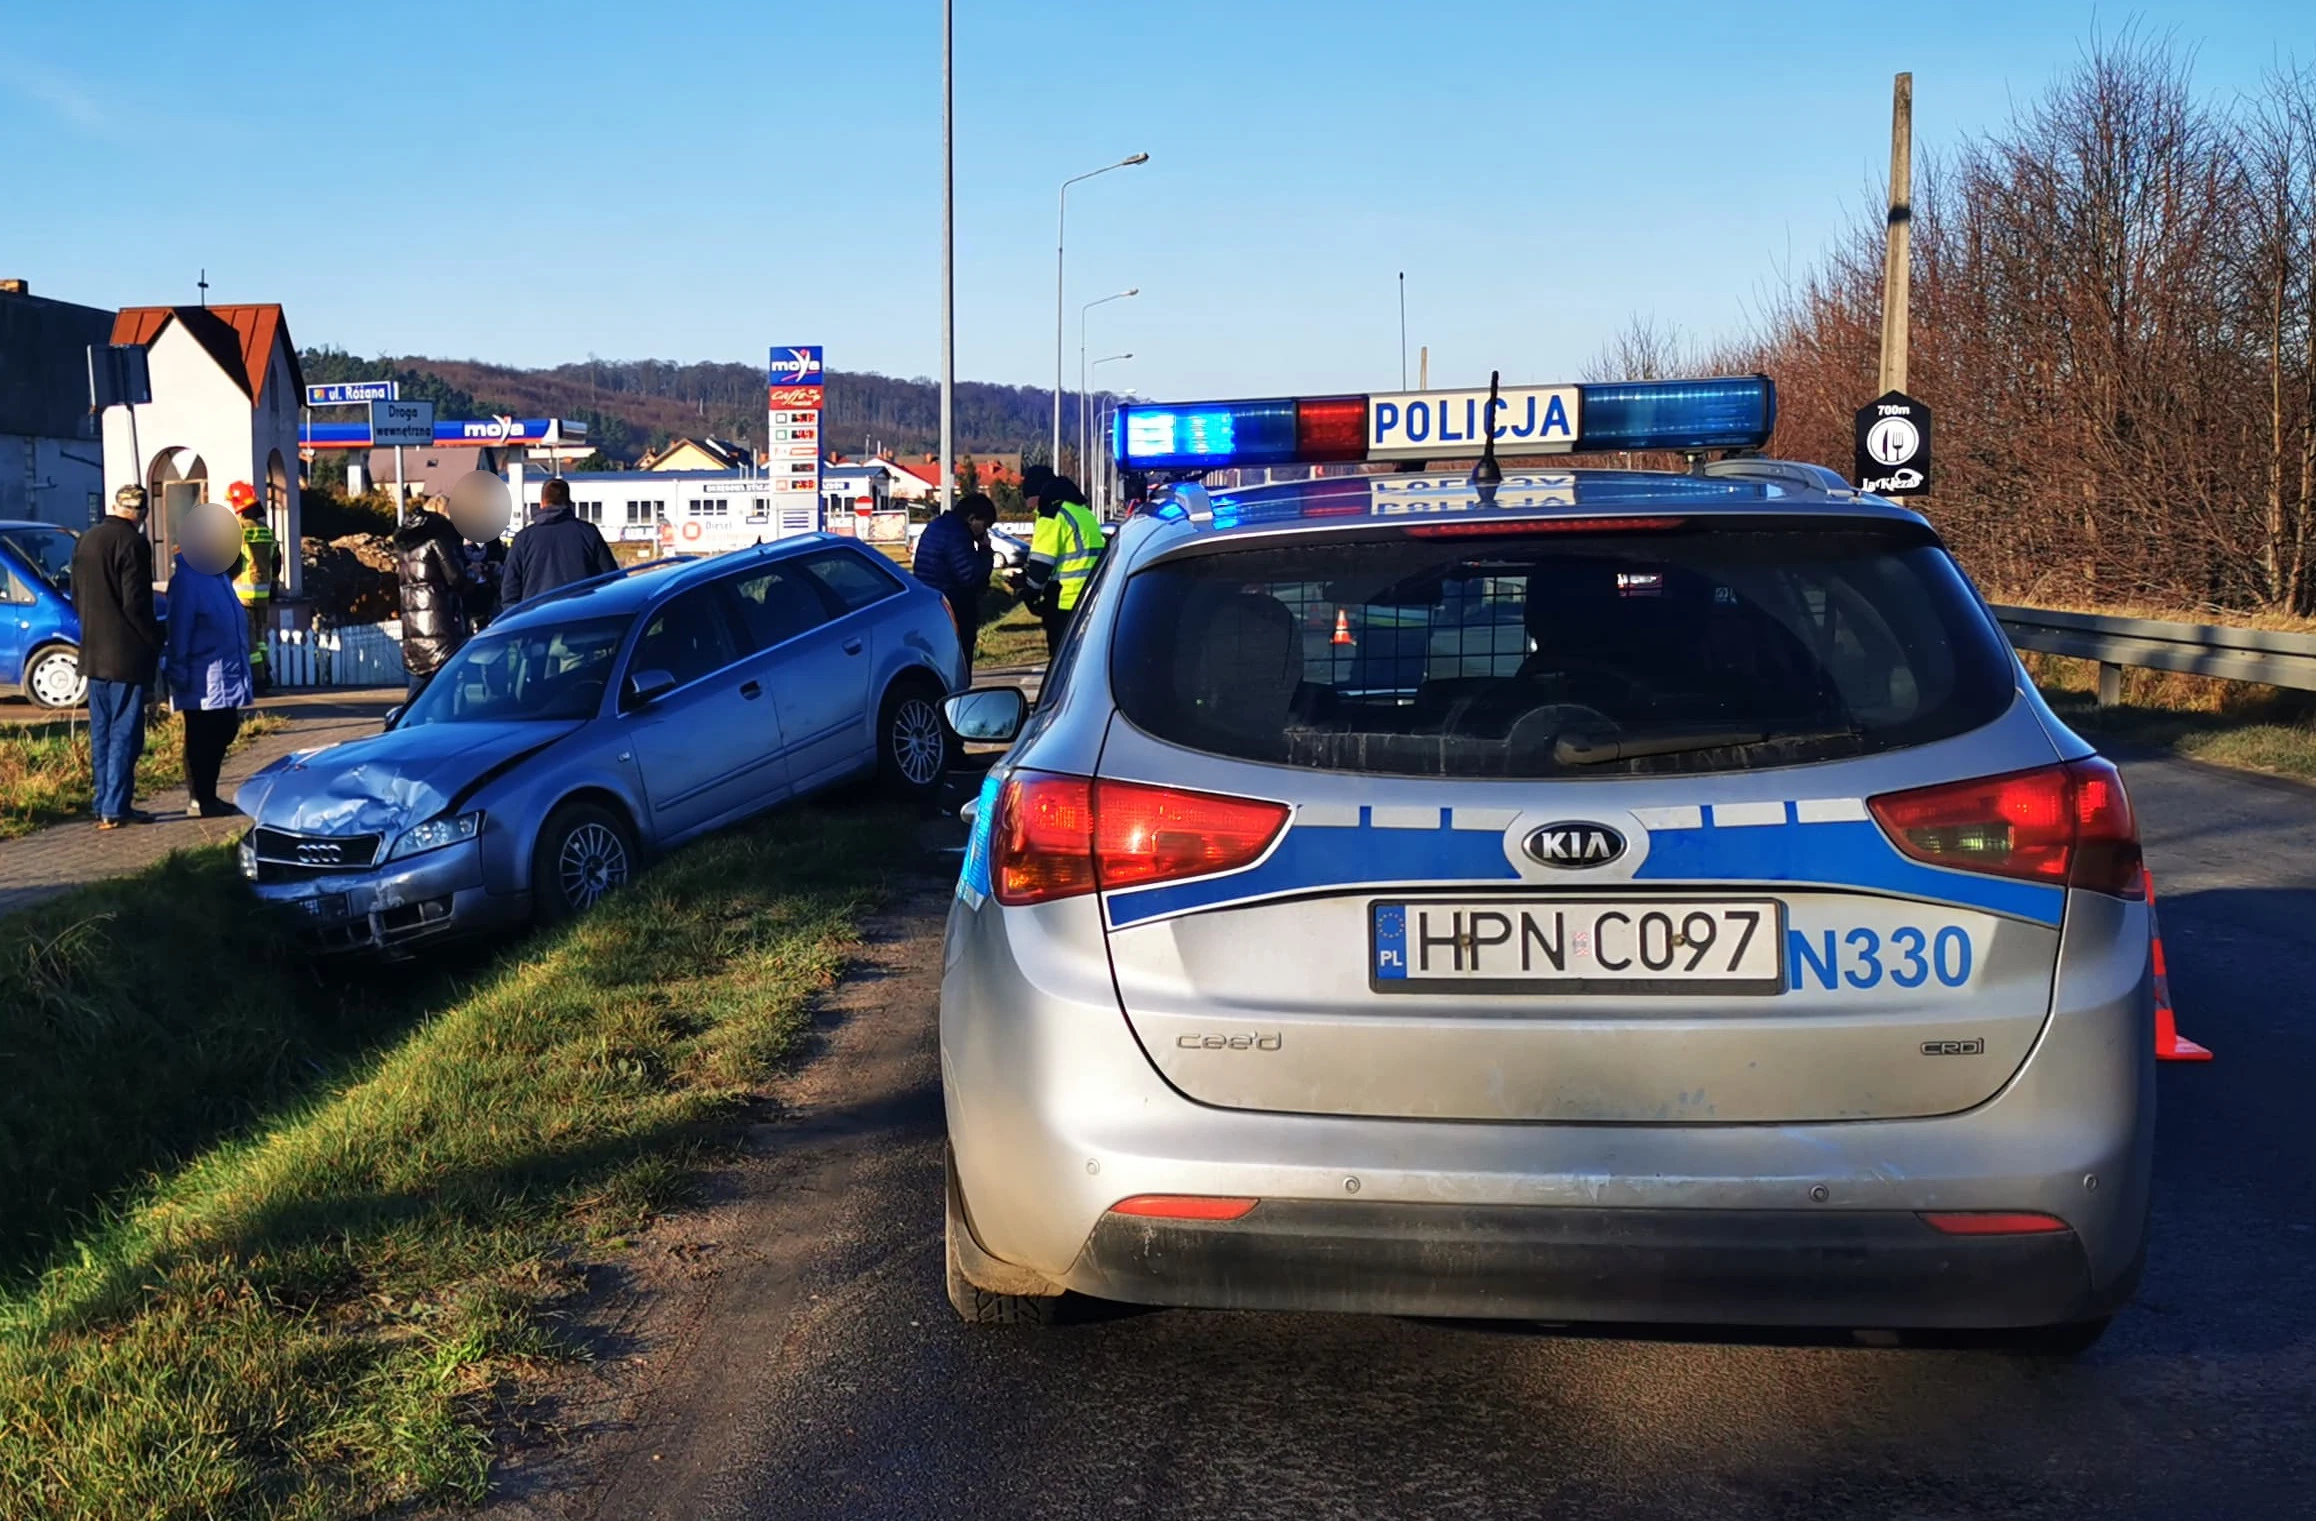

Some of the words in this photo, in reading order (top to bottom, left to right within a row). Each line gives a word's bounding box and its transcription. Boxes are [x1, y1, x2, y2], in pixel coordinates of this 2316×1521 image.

[771, 348, 820, 382] moya
[328, 387, 342, 400] ul.
[345, 385, 385, 400] Różana
[388, 404, 418, 421] Droga
[1375, 395, 1571, 443] POLICJA
[1877, 405, 1910, 415] 700m
[376, 426, 431, 438] wewnętrzna
[464, 414, 524, 442] moya
[1542, 832, 1611, 860] KIA
[1419, 911, 1566, 972] HPN
[1593, 911, 1760, 972] C097
[1380, 950, 1403, 967] PL
[1789, 925, 1973, 991] N330
[1176, 1030, 1282, 1051] cee'd
